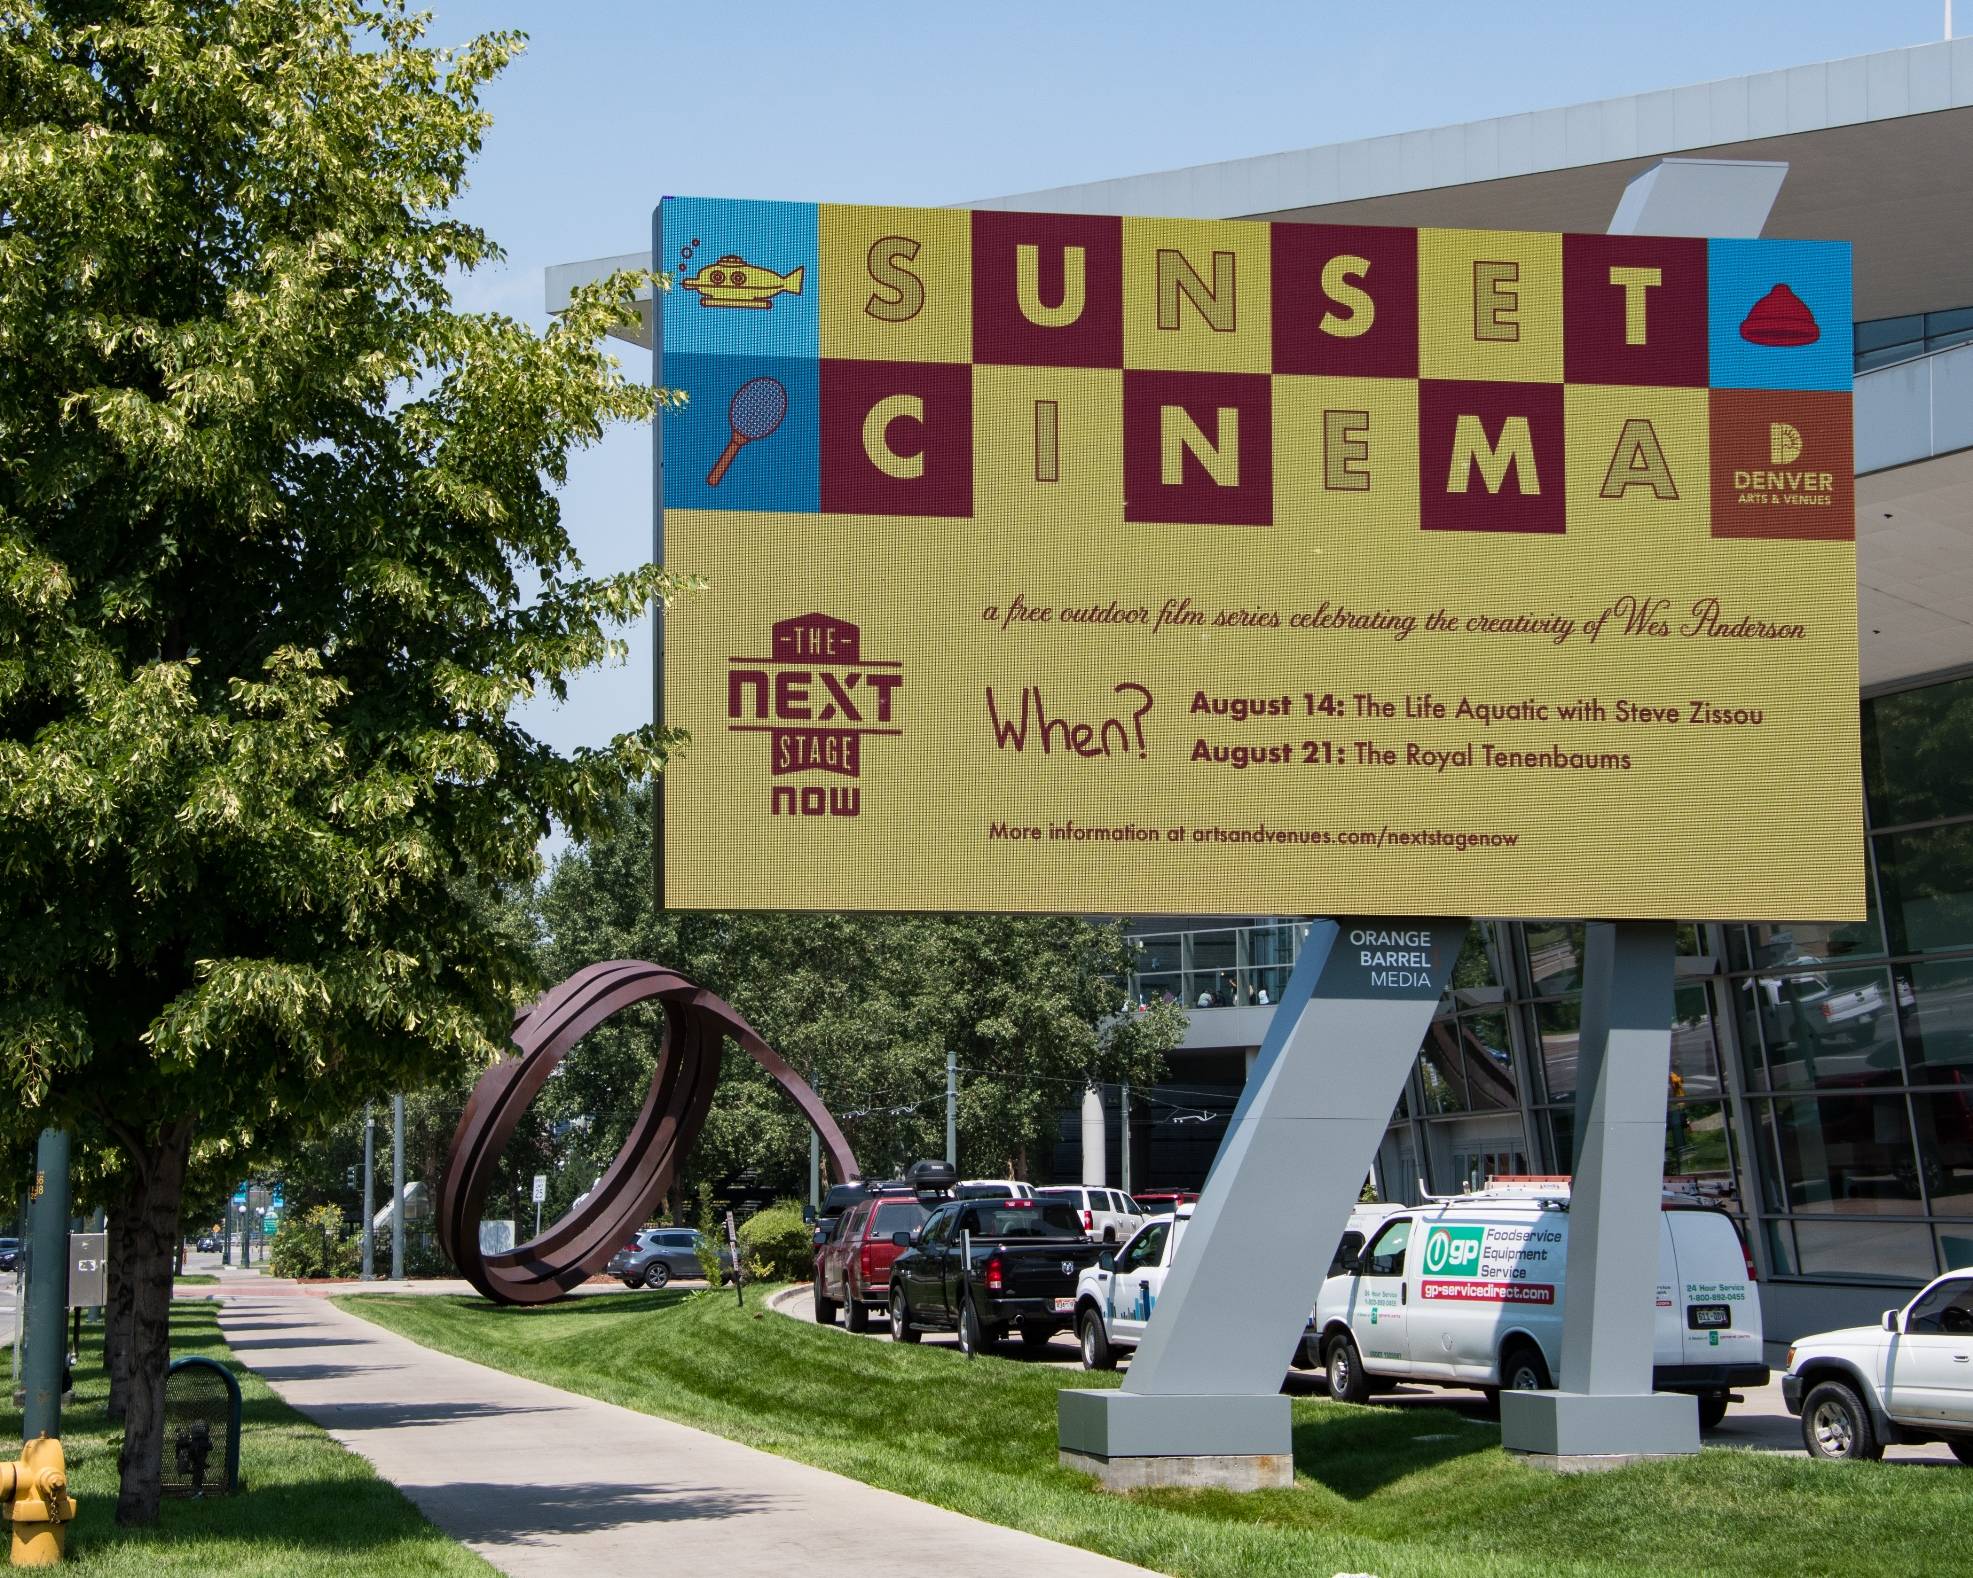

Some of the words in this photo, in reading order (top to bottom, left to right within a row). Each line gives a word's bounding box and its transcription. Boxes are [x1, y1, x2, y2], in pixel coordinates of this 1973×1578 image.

[865, 236, 1662, 345] SUNSET
[862, 394, 1680, 501] CINEMA
[1734, 471, 1833, 491] DENVER
[1738, 493, 1768, 504] ARTS
[1771, 494, 1780, 504] &
[1783, 494, 1831, 505] VENUES
[983, 604, 1000, 621] a
[1001, 593, 1052, 631] free
[1060, 600, 1150, 624] outdoor
[1152, 597, 1206, 634] film
[1211, 605, 1281, 628] series
[1290, 601, 1417, 641] celebrating
[1425, 608, 1460, 632] the
[1466, 611, 1577, 645] creativity
[1583, 607, 1612, 644] of
[1613, 595, 1671, 637] Wes
[1680, 596, 1806, 639] Anderson
[1190, 690, 1292, 721] August
[1303, 692, 1345, 717] 14:
[1352, 692, 1396, 718] The
[1405, 693, 1446, 719] Life
[1455, 695, 1549, 726] Aquatic
[1557, 698, 1606, 722] with
[1615, 699, 1680, 724] Steve
[1689, 700, 1764, 725] Zissou
[985, 682, 1154, 760] When?
[780, 735, 851, 769] STAGE
[1190, 738, 1293, 769] August
[1302, 740, 1346, 765] 21:
[1353, 740, 1397, 766] The
[1406, 742, 1472, 774] Royal
[1482, 743, 1632, 770] Tenenbaums
[989, 822, 1042, 840] More
[1049, 820, 1160, 842] information
[1166, 825, 1185, 842] at
[1192, 823, 1519, 851] artsandvenues.com/nextstagenow
[1350, 930, 1432, 947] ORANGE
[1360, 951, 1432, 968] BARREL
[1371, 971, 1432, 988] MEDIA
[1486, 1228, 1562, 1243] Foodservice
[1448, 1239, 1480, 1266] gp
[1482, 1246, 1548, 1262] Equipment
[1481, 1265, 1527, 1279] Service
[1686, 1284, 1697, 1292] 24
[1699, 1284, 1717, 1292] Hour
[1719, 1283, 1745, 1291] Service
